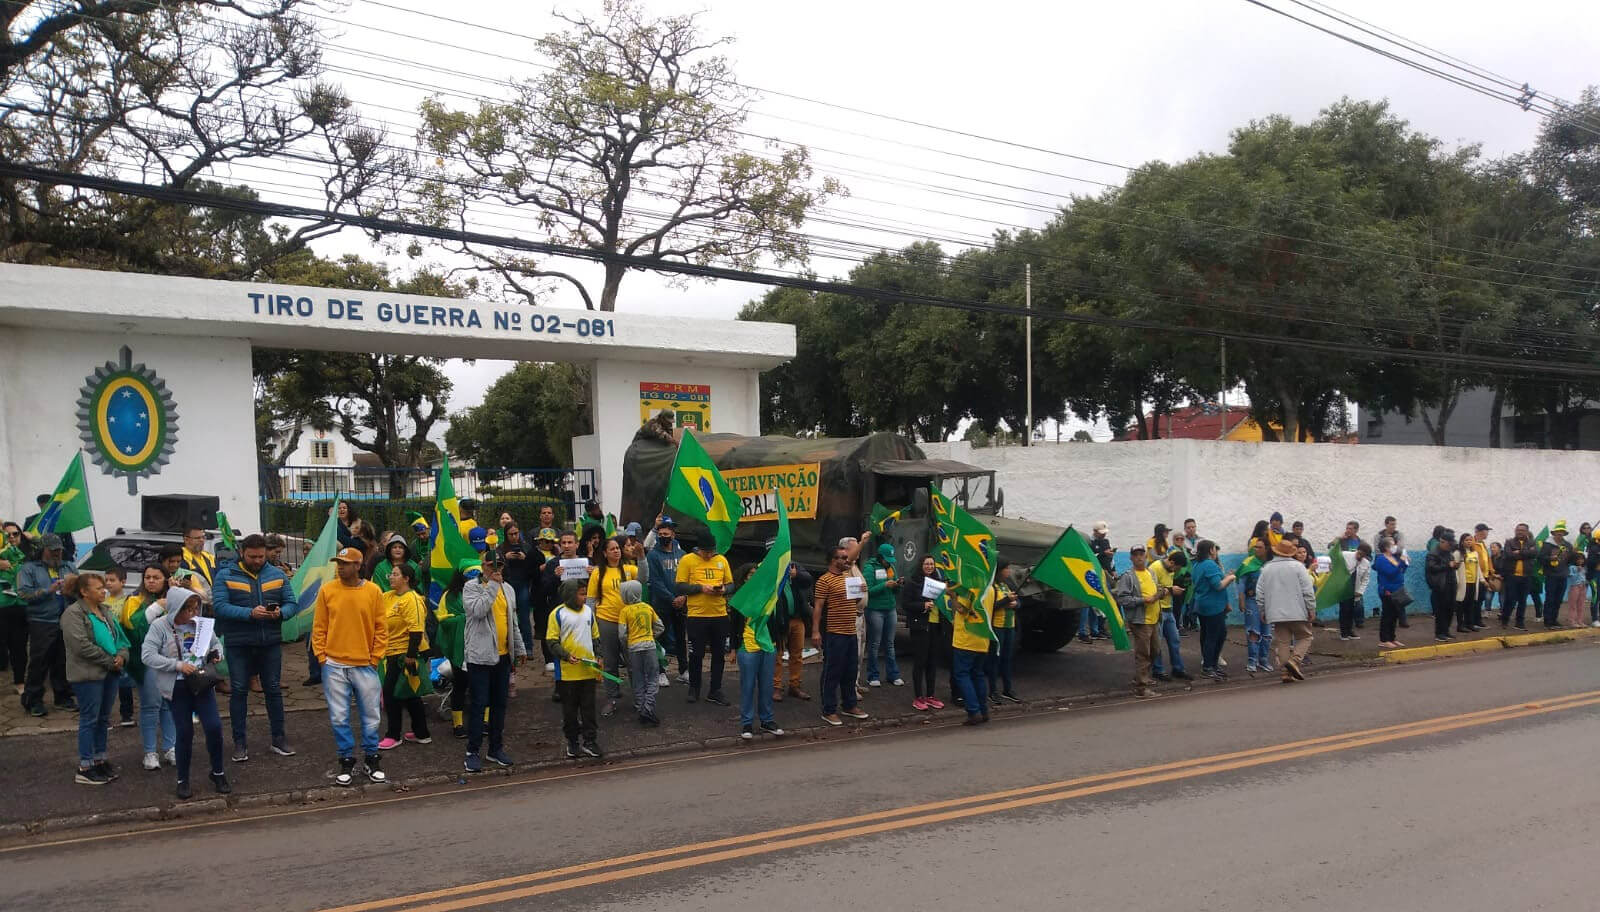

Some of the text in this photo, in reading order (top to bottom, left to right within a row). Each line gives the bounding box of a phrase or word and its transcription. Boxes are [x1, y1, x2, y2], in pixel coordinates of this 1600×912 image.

[247, 292, 314, 317] TIRO
[327, 299, 364, 321] DE
[377, 302, 483, 329] GUERRA
[531, 314, 615, 337] 02-081
[725, 468, 817, 493] NTERVENÇÃO
[741, 491, 811, 517] RAL JÁ!
[703, 567, 714, 579] 10
